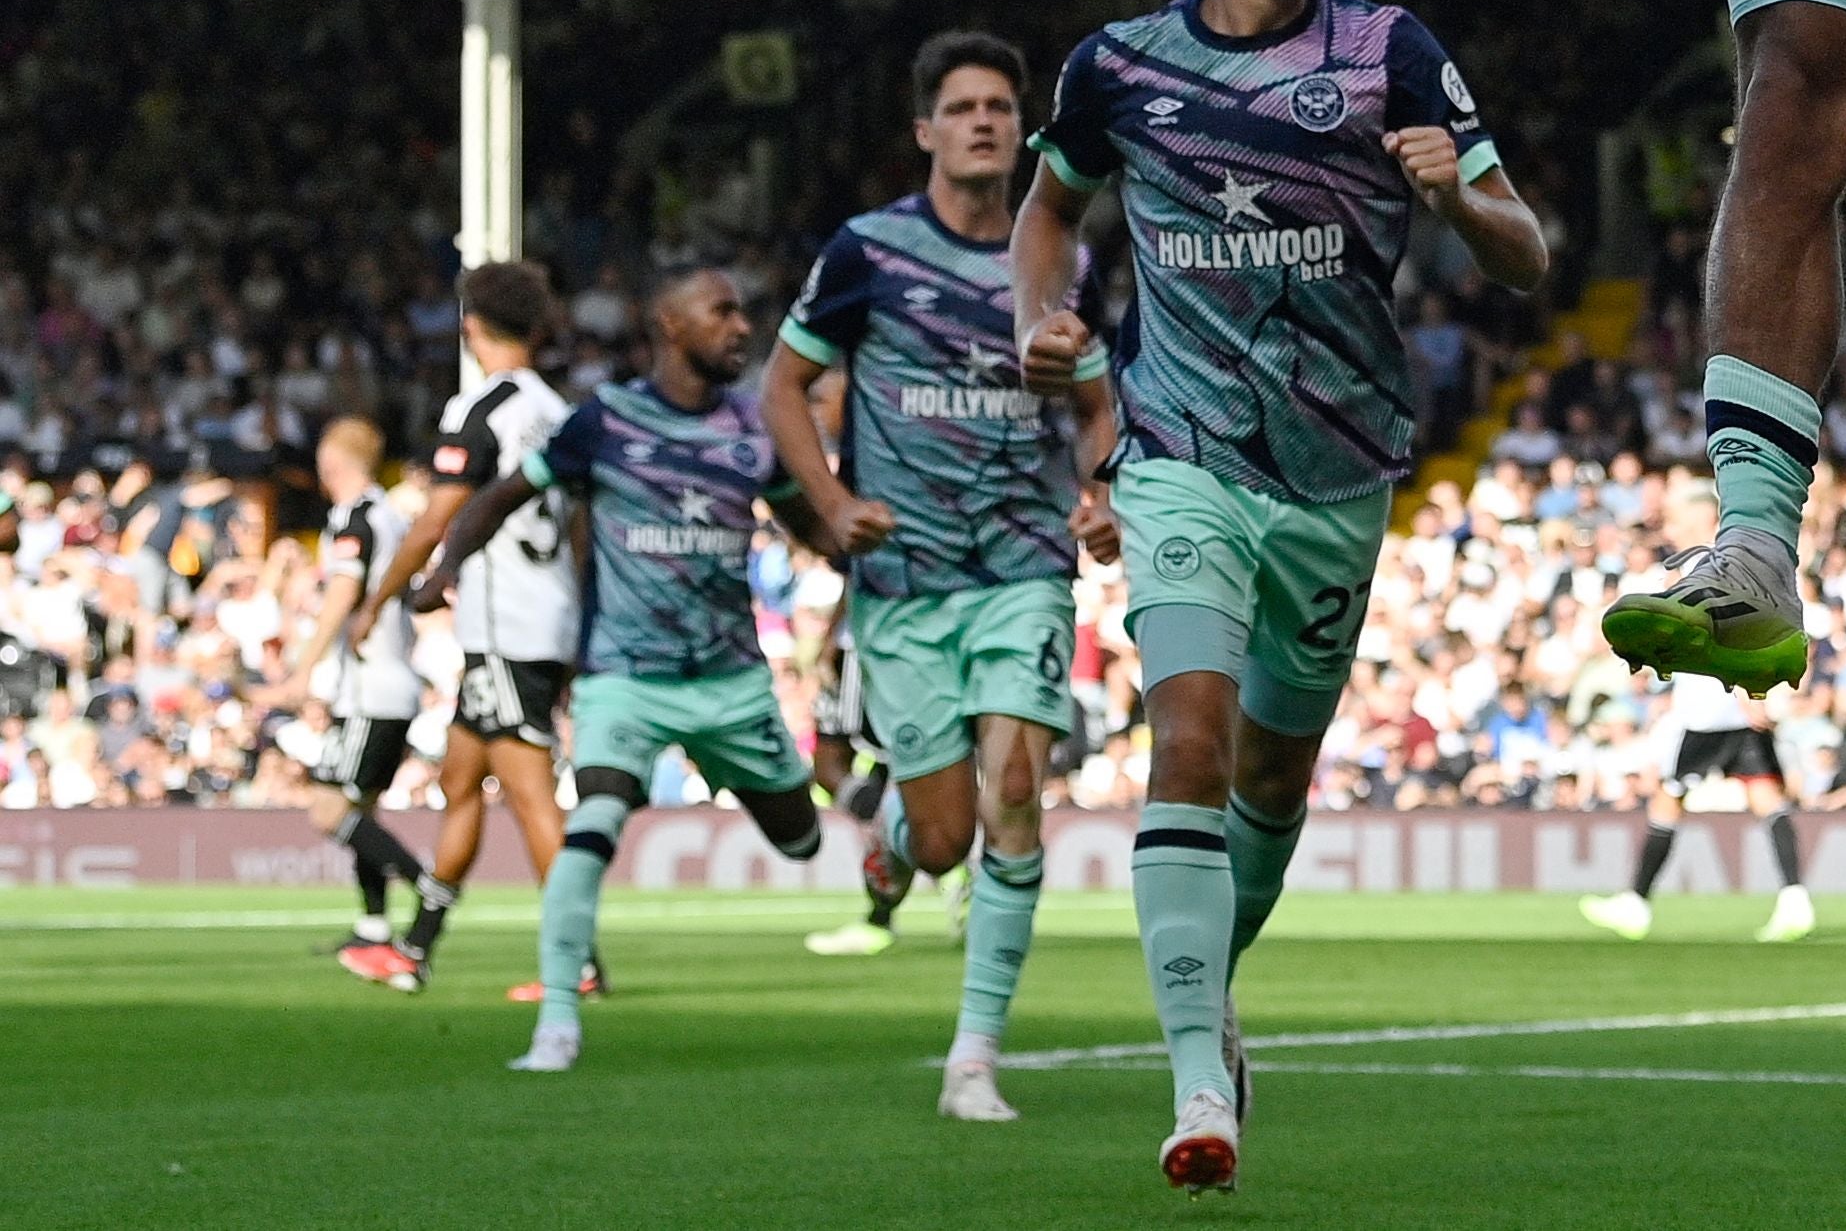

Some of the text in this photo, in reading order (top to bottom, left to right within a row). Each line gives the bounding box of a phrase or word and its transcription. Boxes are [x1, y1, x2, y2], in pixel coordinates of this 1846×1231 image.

[1158, 224, 1344, 269] HOLLYWOOD
[1301, 260, 1343, 282] bets
[1039, 632, 1063, 683] 6
